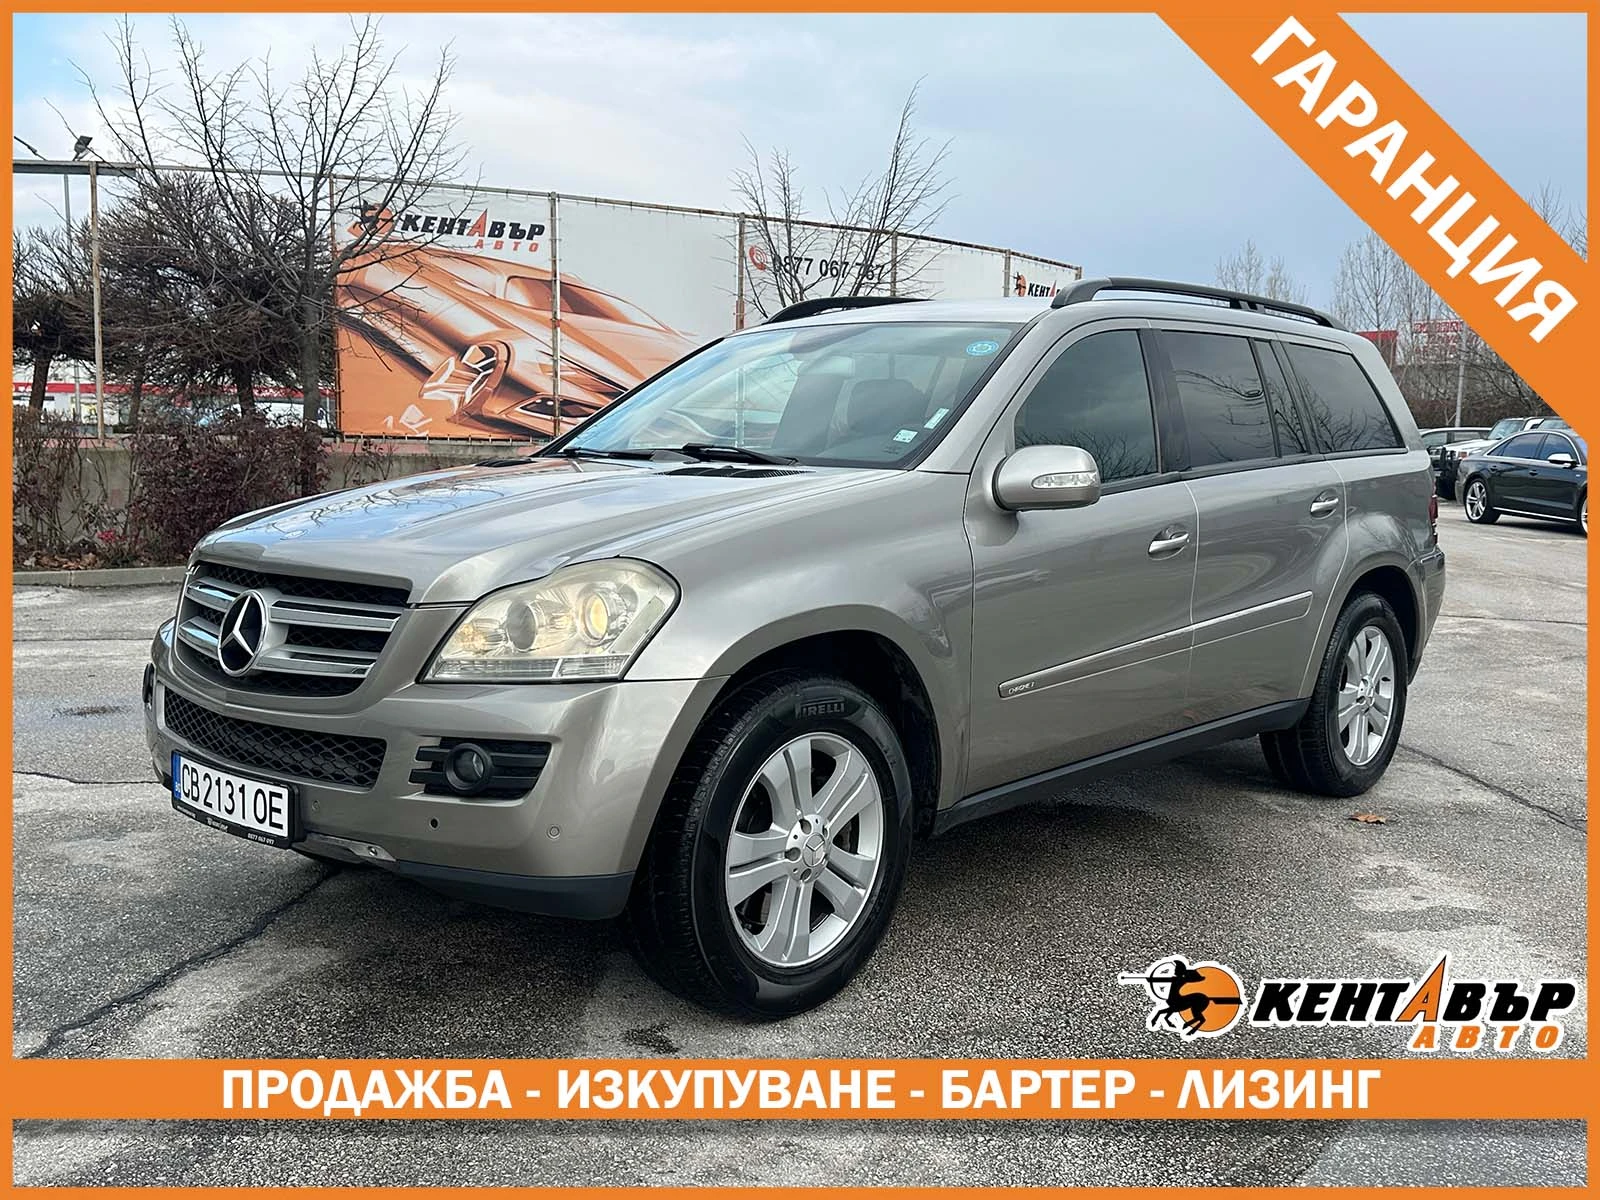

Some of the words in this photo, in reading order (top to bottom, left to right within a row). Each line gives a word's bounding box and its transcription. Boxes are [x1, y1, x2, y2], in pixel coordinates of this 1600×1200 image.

[400, 208, 545, 241] КЕНТАВЪР
[474, 238, 539, 252] АВТО
[795, 696, 845, 719] PIRELLI
